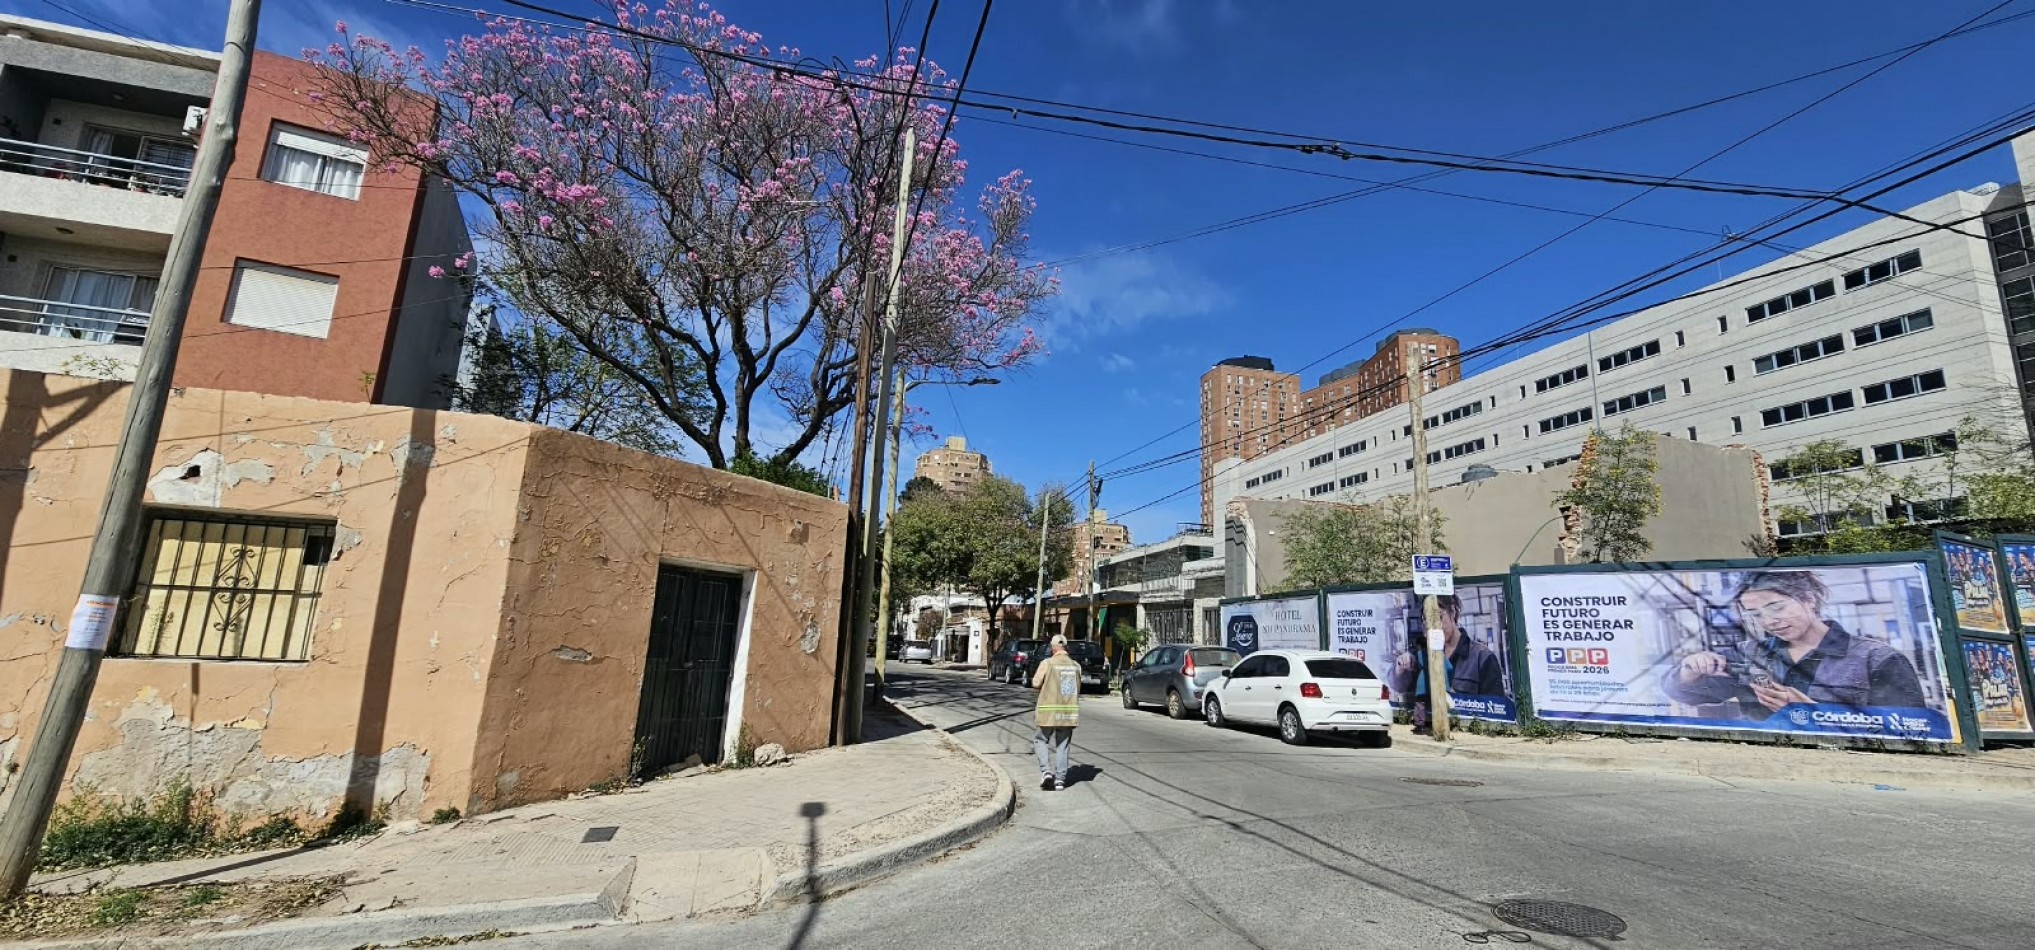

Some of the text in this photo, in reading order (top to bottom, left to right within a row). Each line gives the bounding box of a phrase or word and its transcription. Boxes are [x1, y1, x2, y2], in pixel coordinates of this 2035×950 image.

[1541, 596, 1627, 607] CONSTRUIR
[1275, 610, 1302, 621] HOTEL
[1337, 609, 1373, 618] CONSTRUIR
[1542, 608, 1600, 618] FUTURO
[1337, 618, 1362, 626] FUTURO
[1543, 619, 1634, 630] ES GENERAR
[1337, 627, 1376, 635] ES GENERAR
[1544, 631, 1615, 641] TRABAJO
[1338, 636, 1368, 644] TRABAJO
[1582, 666, 1610, 675] 2026
[1453, 698, 1485, 709] Córdoba
[1812, 711, 1884, 725] Córdoba
